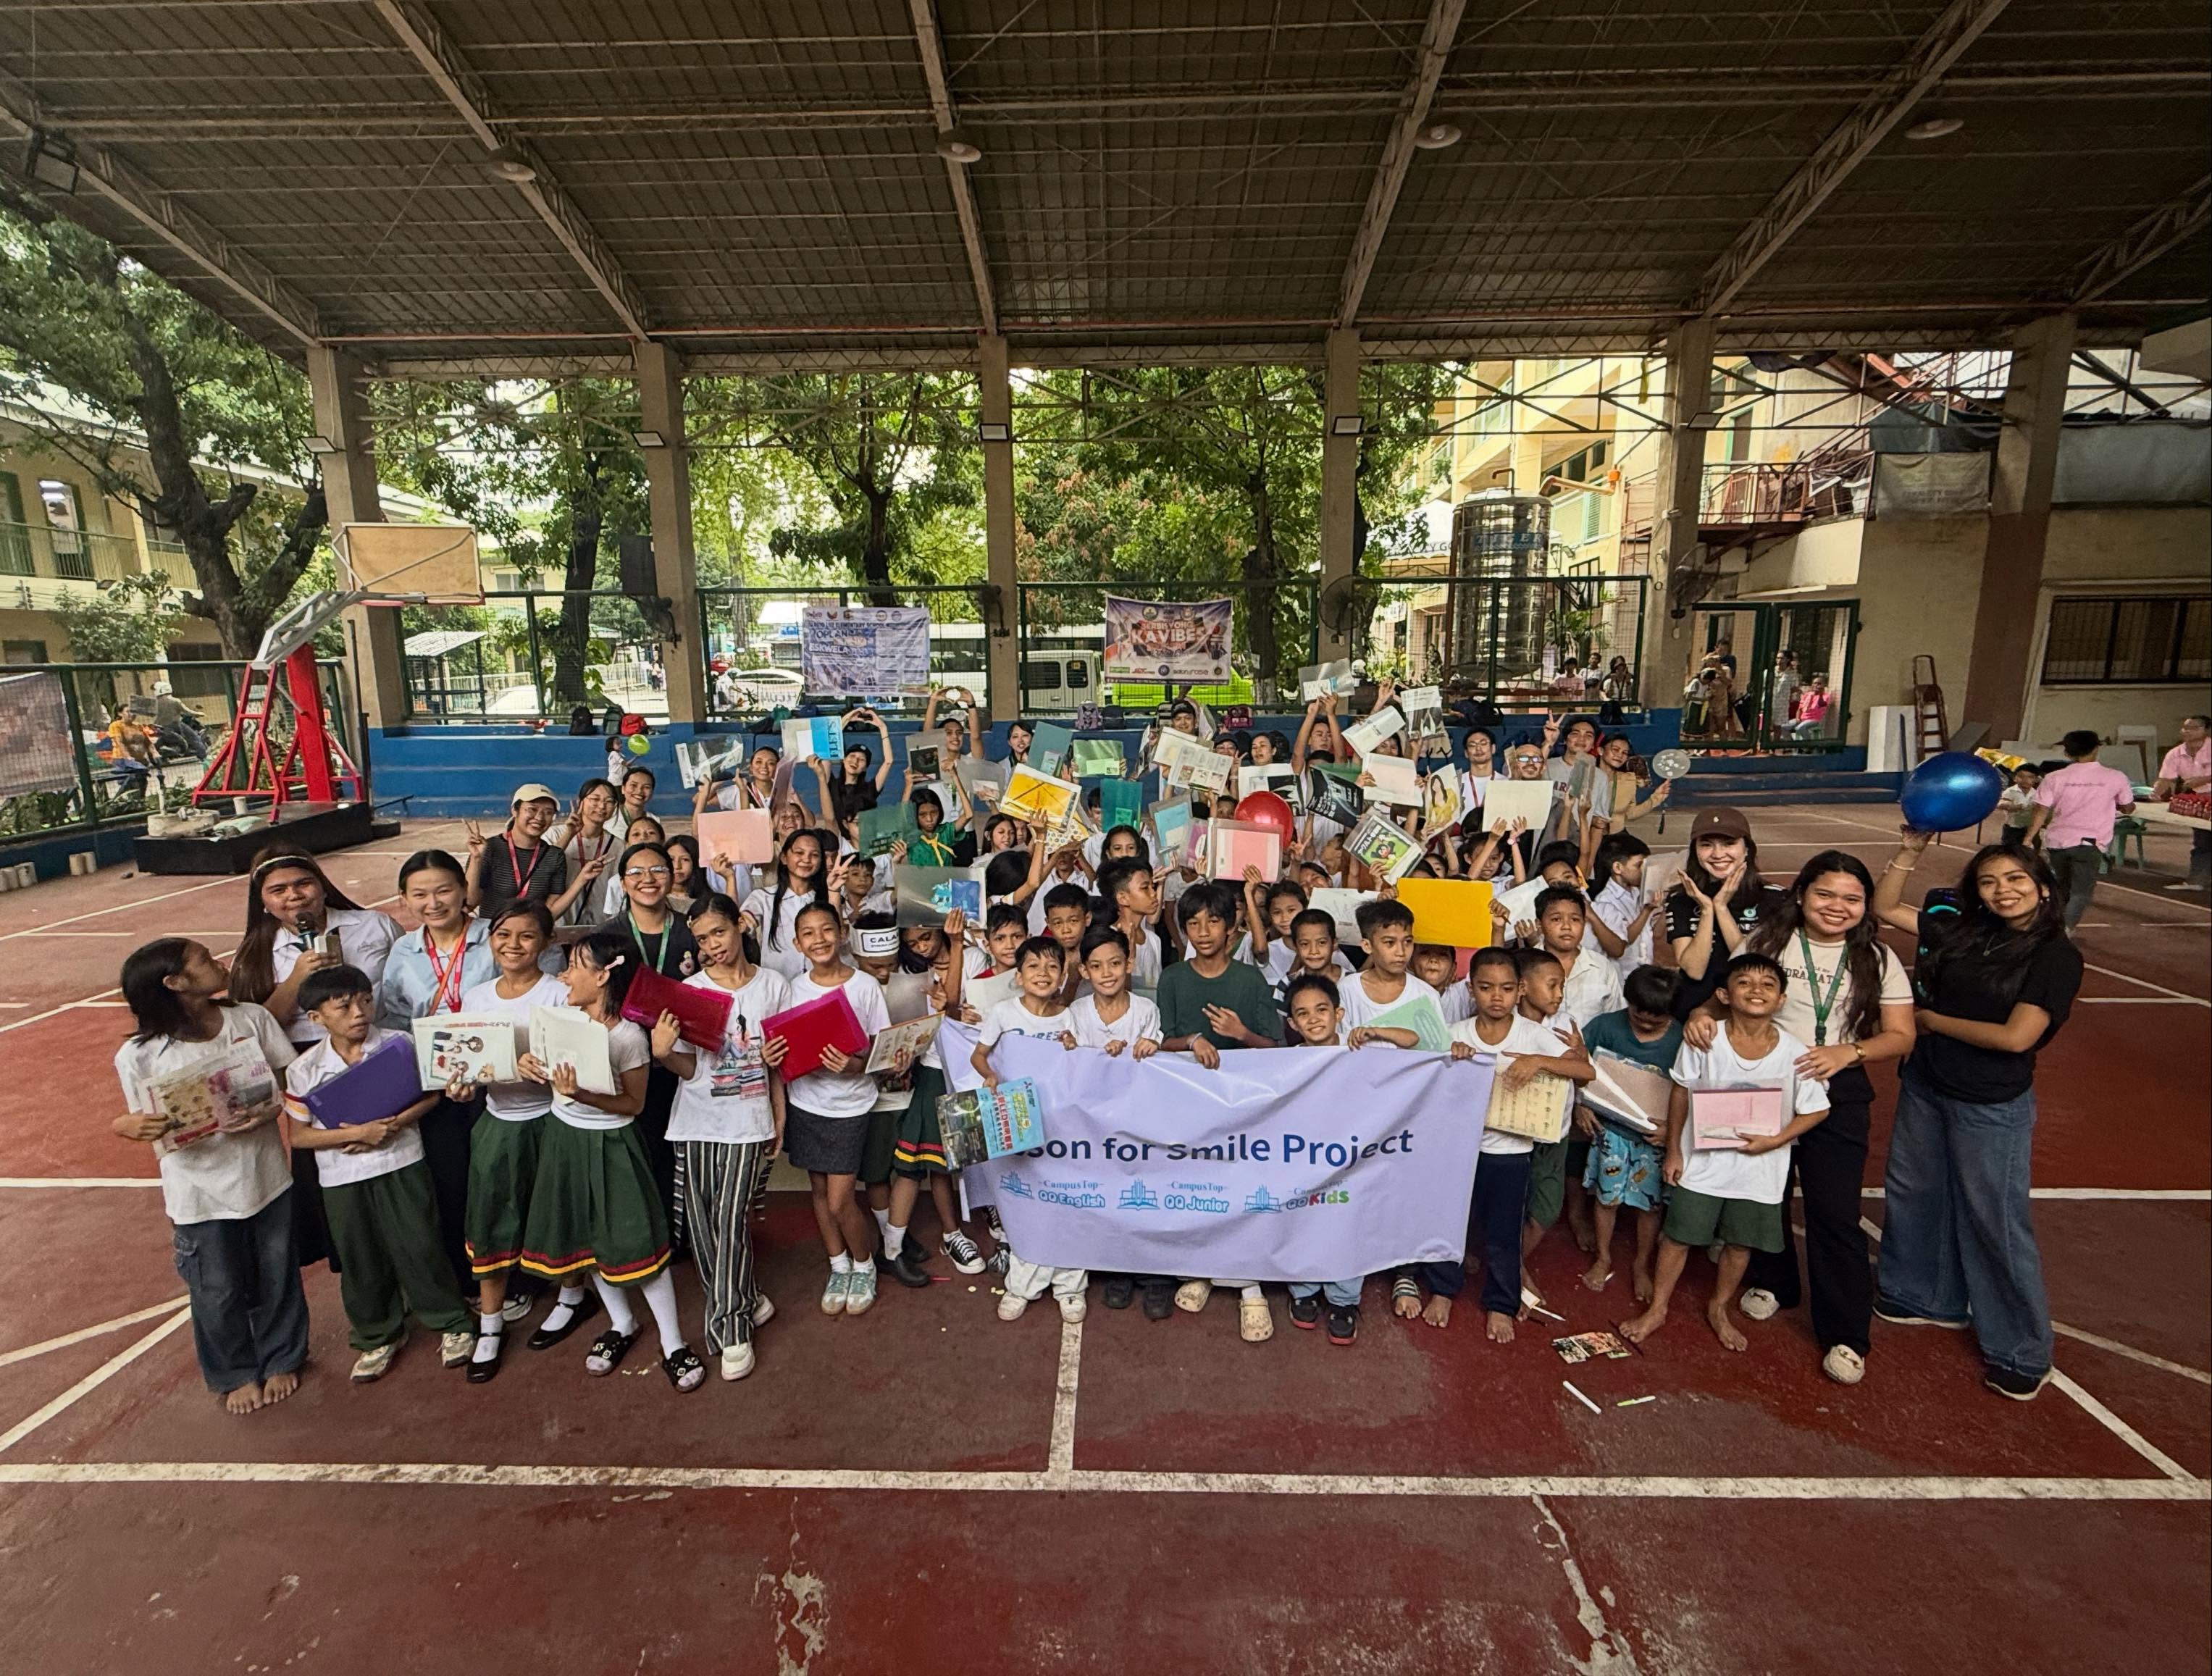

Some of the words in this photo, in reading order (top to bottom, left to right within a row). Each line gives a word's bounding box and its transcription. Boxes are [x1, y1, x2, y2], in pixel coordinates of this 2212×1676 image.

[816, 629, 847, 638] OPLAN
[809, 643, 850, 654] ESKWELA
[870, 933, 899, 943] CALA
[1102, 1137, 1156, 1162] for
[1166, 1134, 1270, 1161] smile
[1283, 1129, 1414, 1170] Project
[1165, 1194, 1185, 1210] QQ
[1186, 1195, 1229, 1213] Junior
